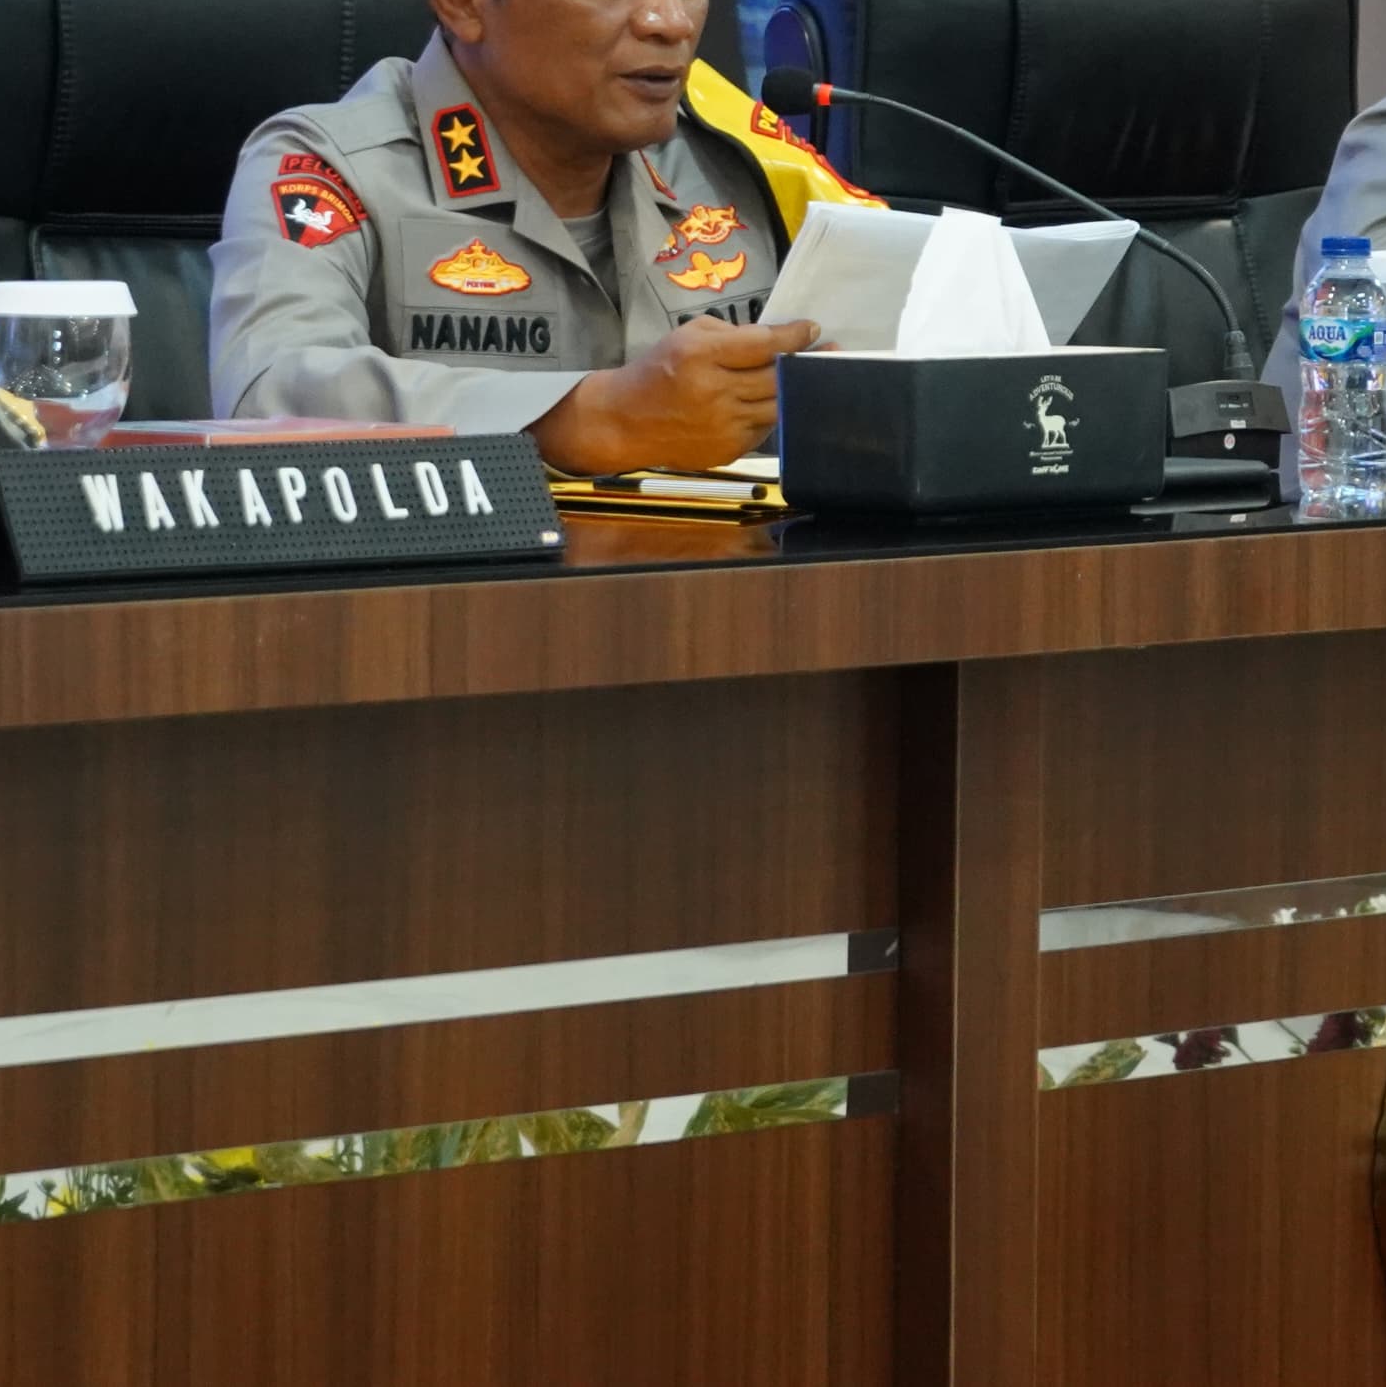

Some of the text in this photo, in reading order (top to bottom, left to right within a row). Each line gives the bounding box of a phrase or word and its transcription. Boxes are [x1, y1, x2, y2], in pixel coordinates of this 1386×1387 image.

[411, 313, 551, 354] NANANG
[1308, 325, 1347, 343] AQUA
[81, 458, 494, 533] WAKAPOLDA
